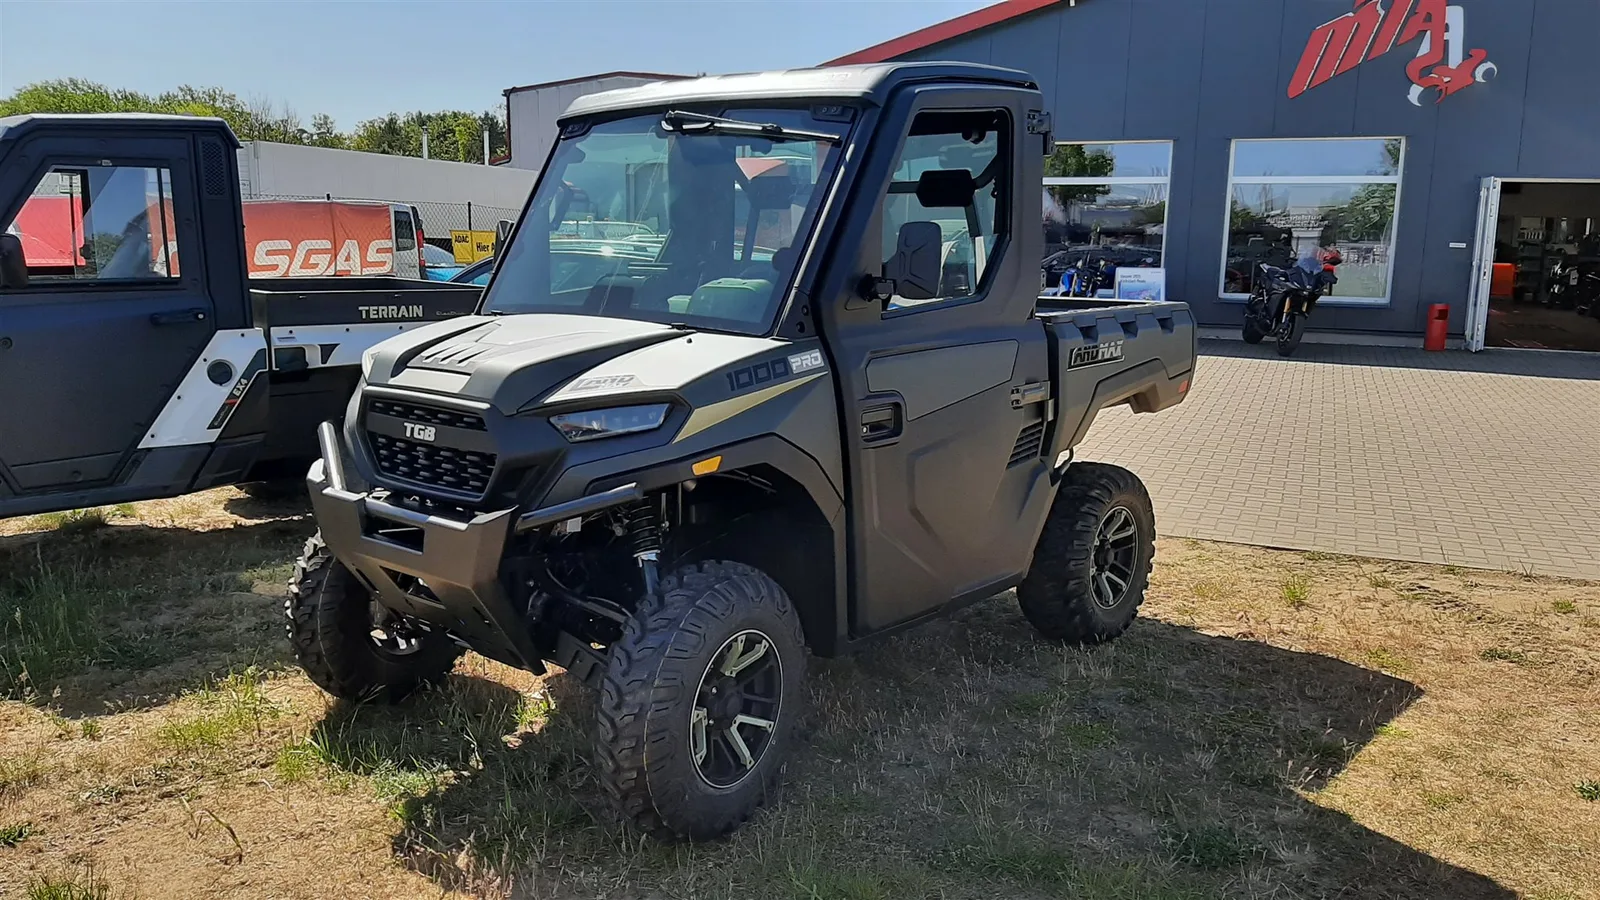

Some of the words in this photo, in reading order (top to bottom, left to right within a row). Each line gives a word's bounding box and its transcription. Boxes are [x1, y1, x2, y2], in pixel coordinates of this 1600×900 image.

[454, 234, 469, 243] ADAC
[475, 241, 489, 252] Hier
[358, 305, 423, 319] TERRAIN
[726, 357, 789, 391] 1000
[789, 352, 822, 372] PRO
[232, 378, 248, 397] EX4
[403, 422, 436, 442] TGB
